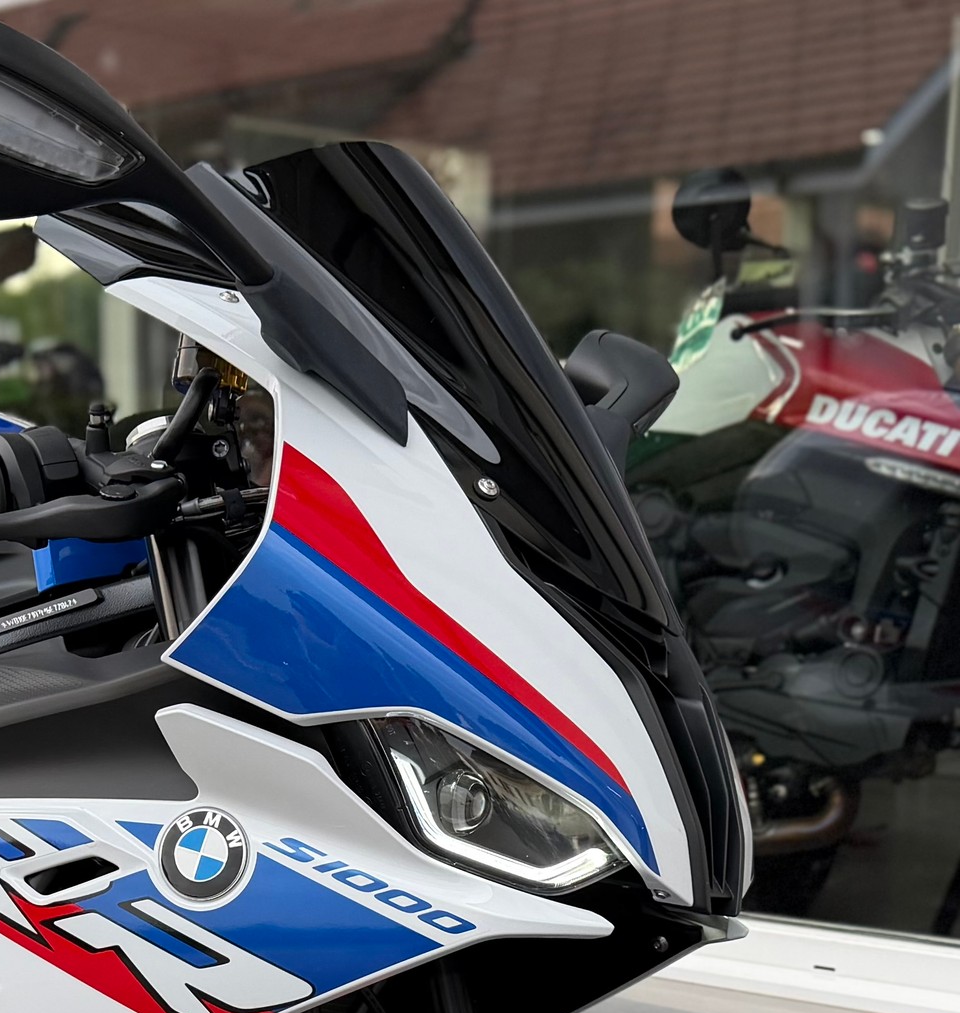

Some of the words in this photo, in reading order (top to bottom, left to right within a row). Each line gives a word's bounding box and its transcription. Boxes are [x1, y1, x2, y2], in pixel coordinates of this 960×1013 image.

[805, 393, 960, 457] DUCATI
[176, 811, 243, 849] BMW
[262, 837, 477, 935] S1000
